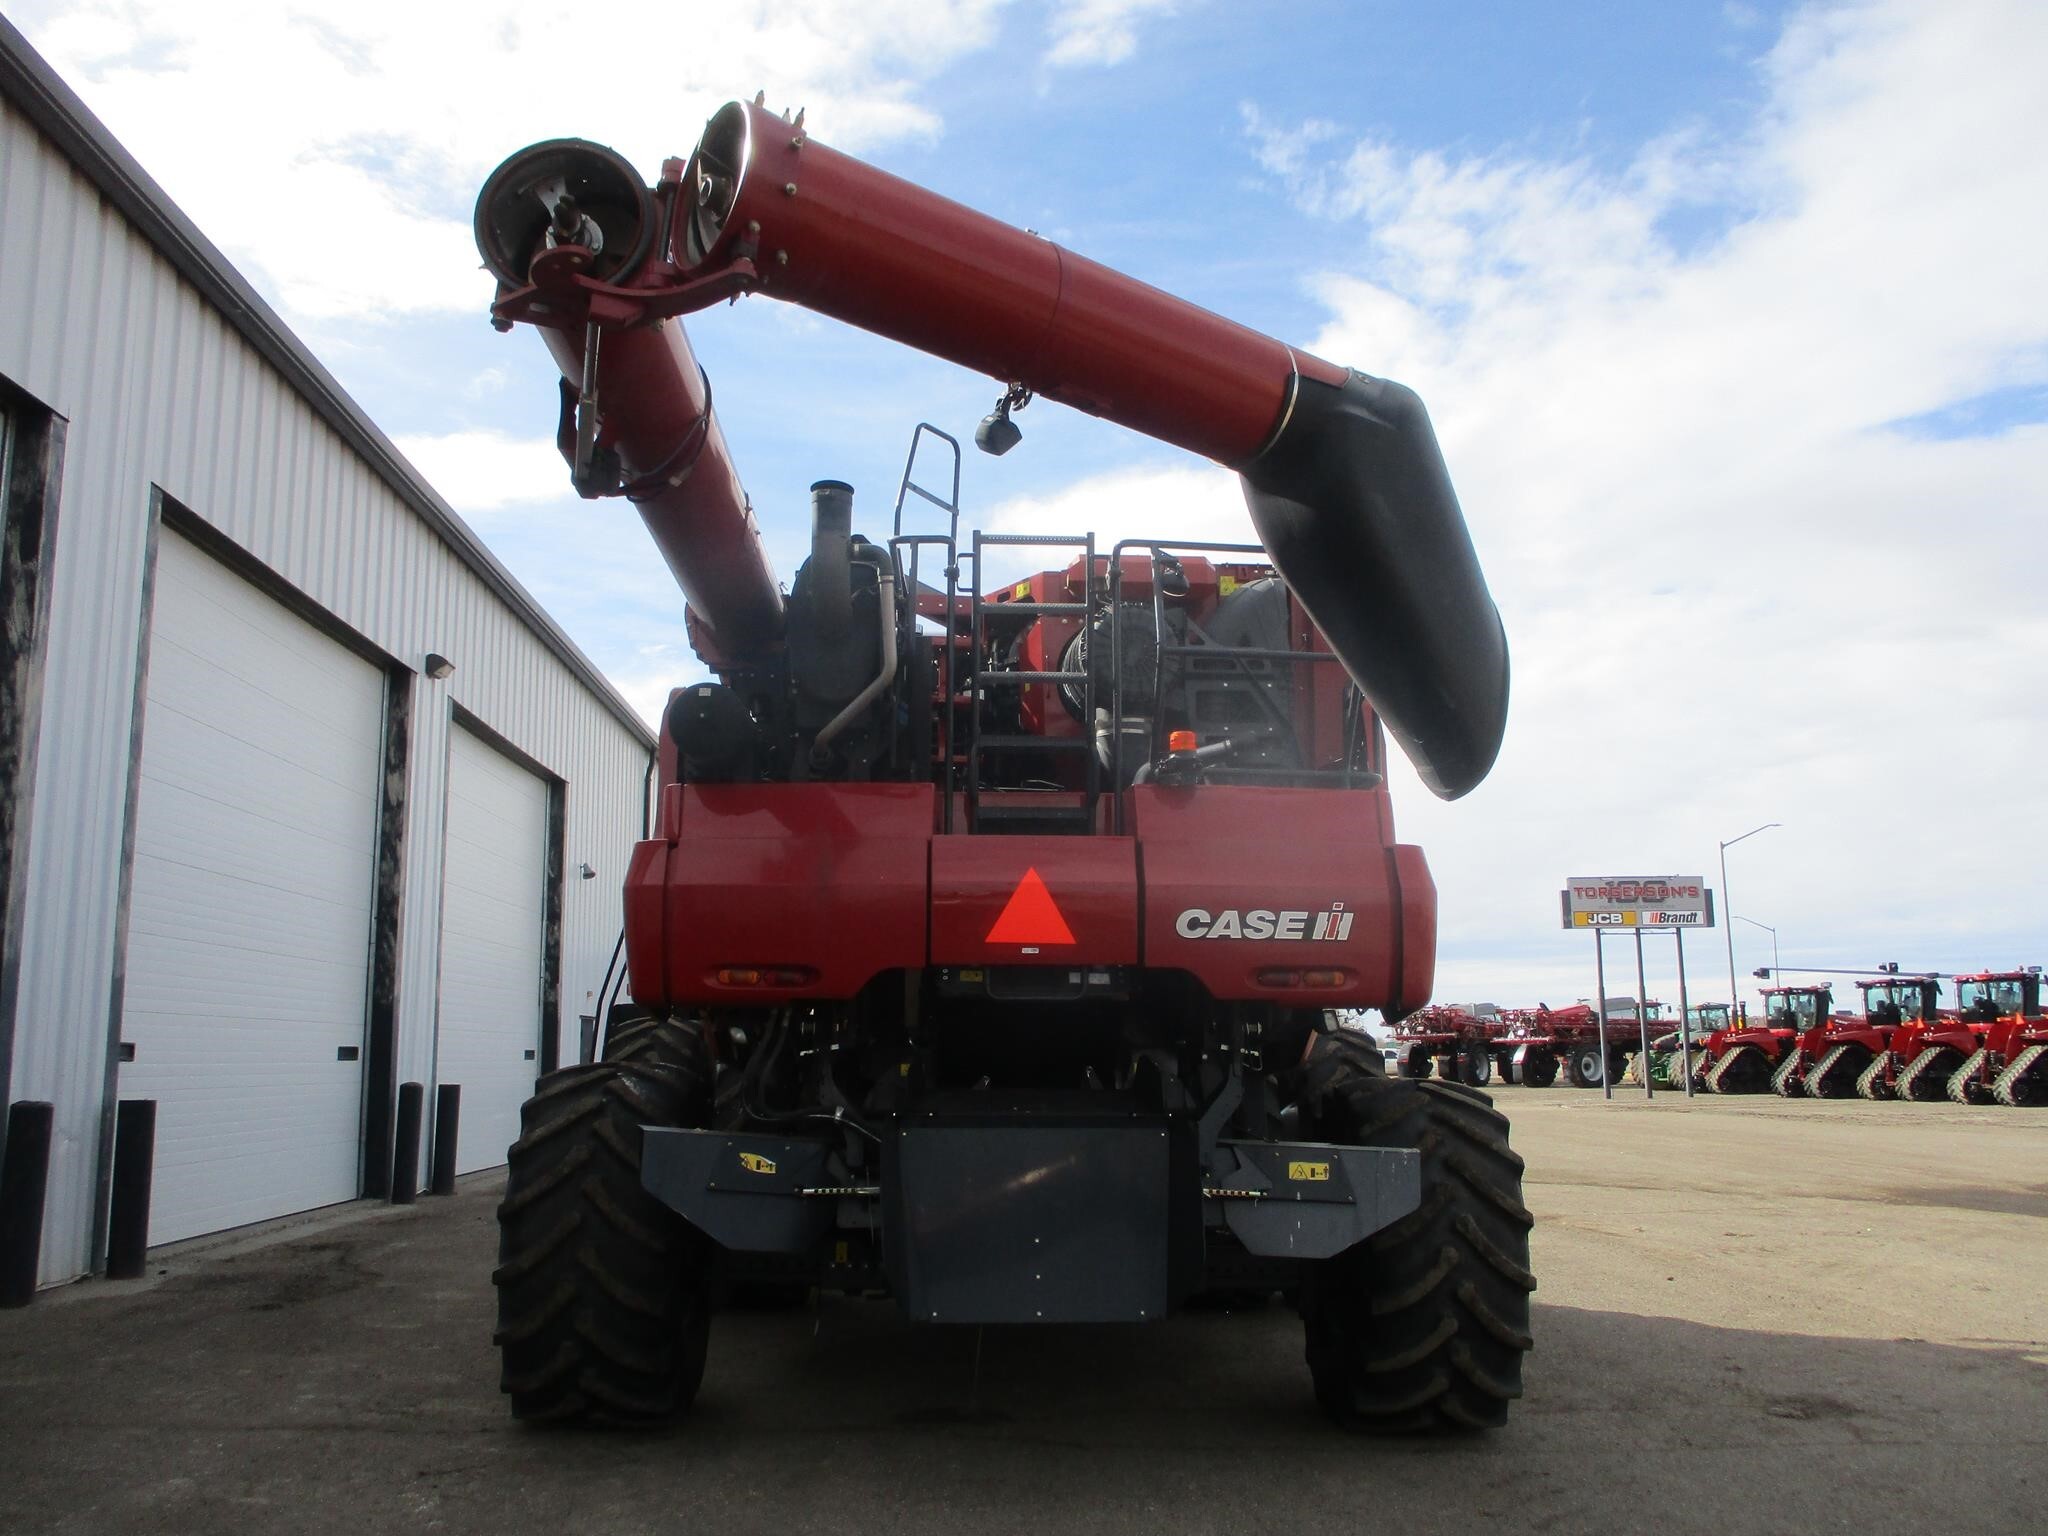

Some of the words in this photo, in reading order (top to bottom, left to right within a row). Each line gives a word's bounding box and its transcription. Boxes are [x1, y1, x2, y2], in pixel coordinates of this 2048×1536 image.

[1175, 908, 1309, 940] CASE
[1588, 912, 1624, 925] JCB
[1658, 912, 1698, 924] Brandt
